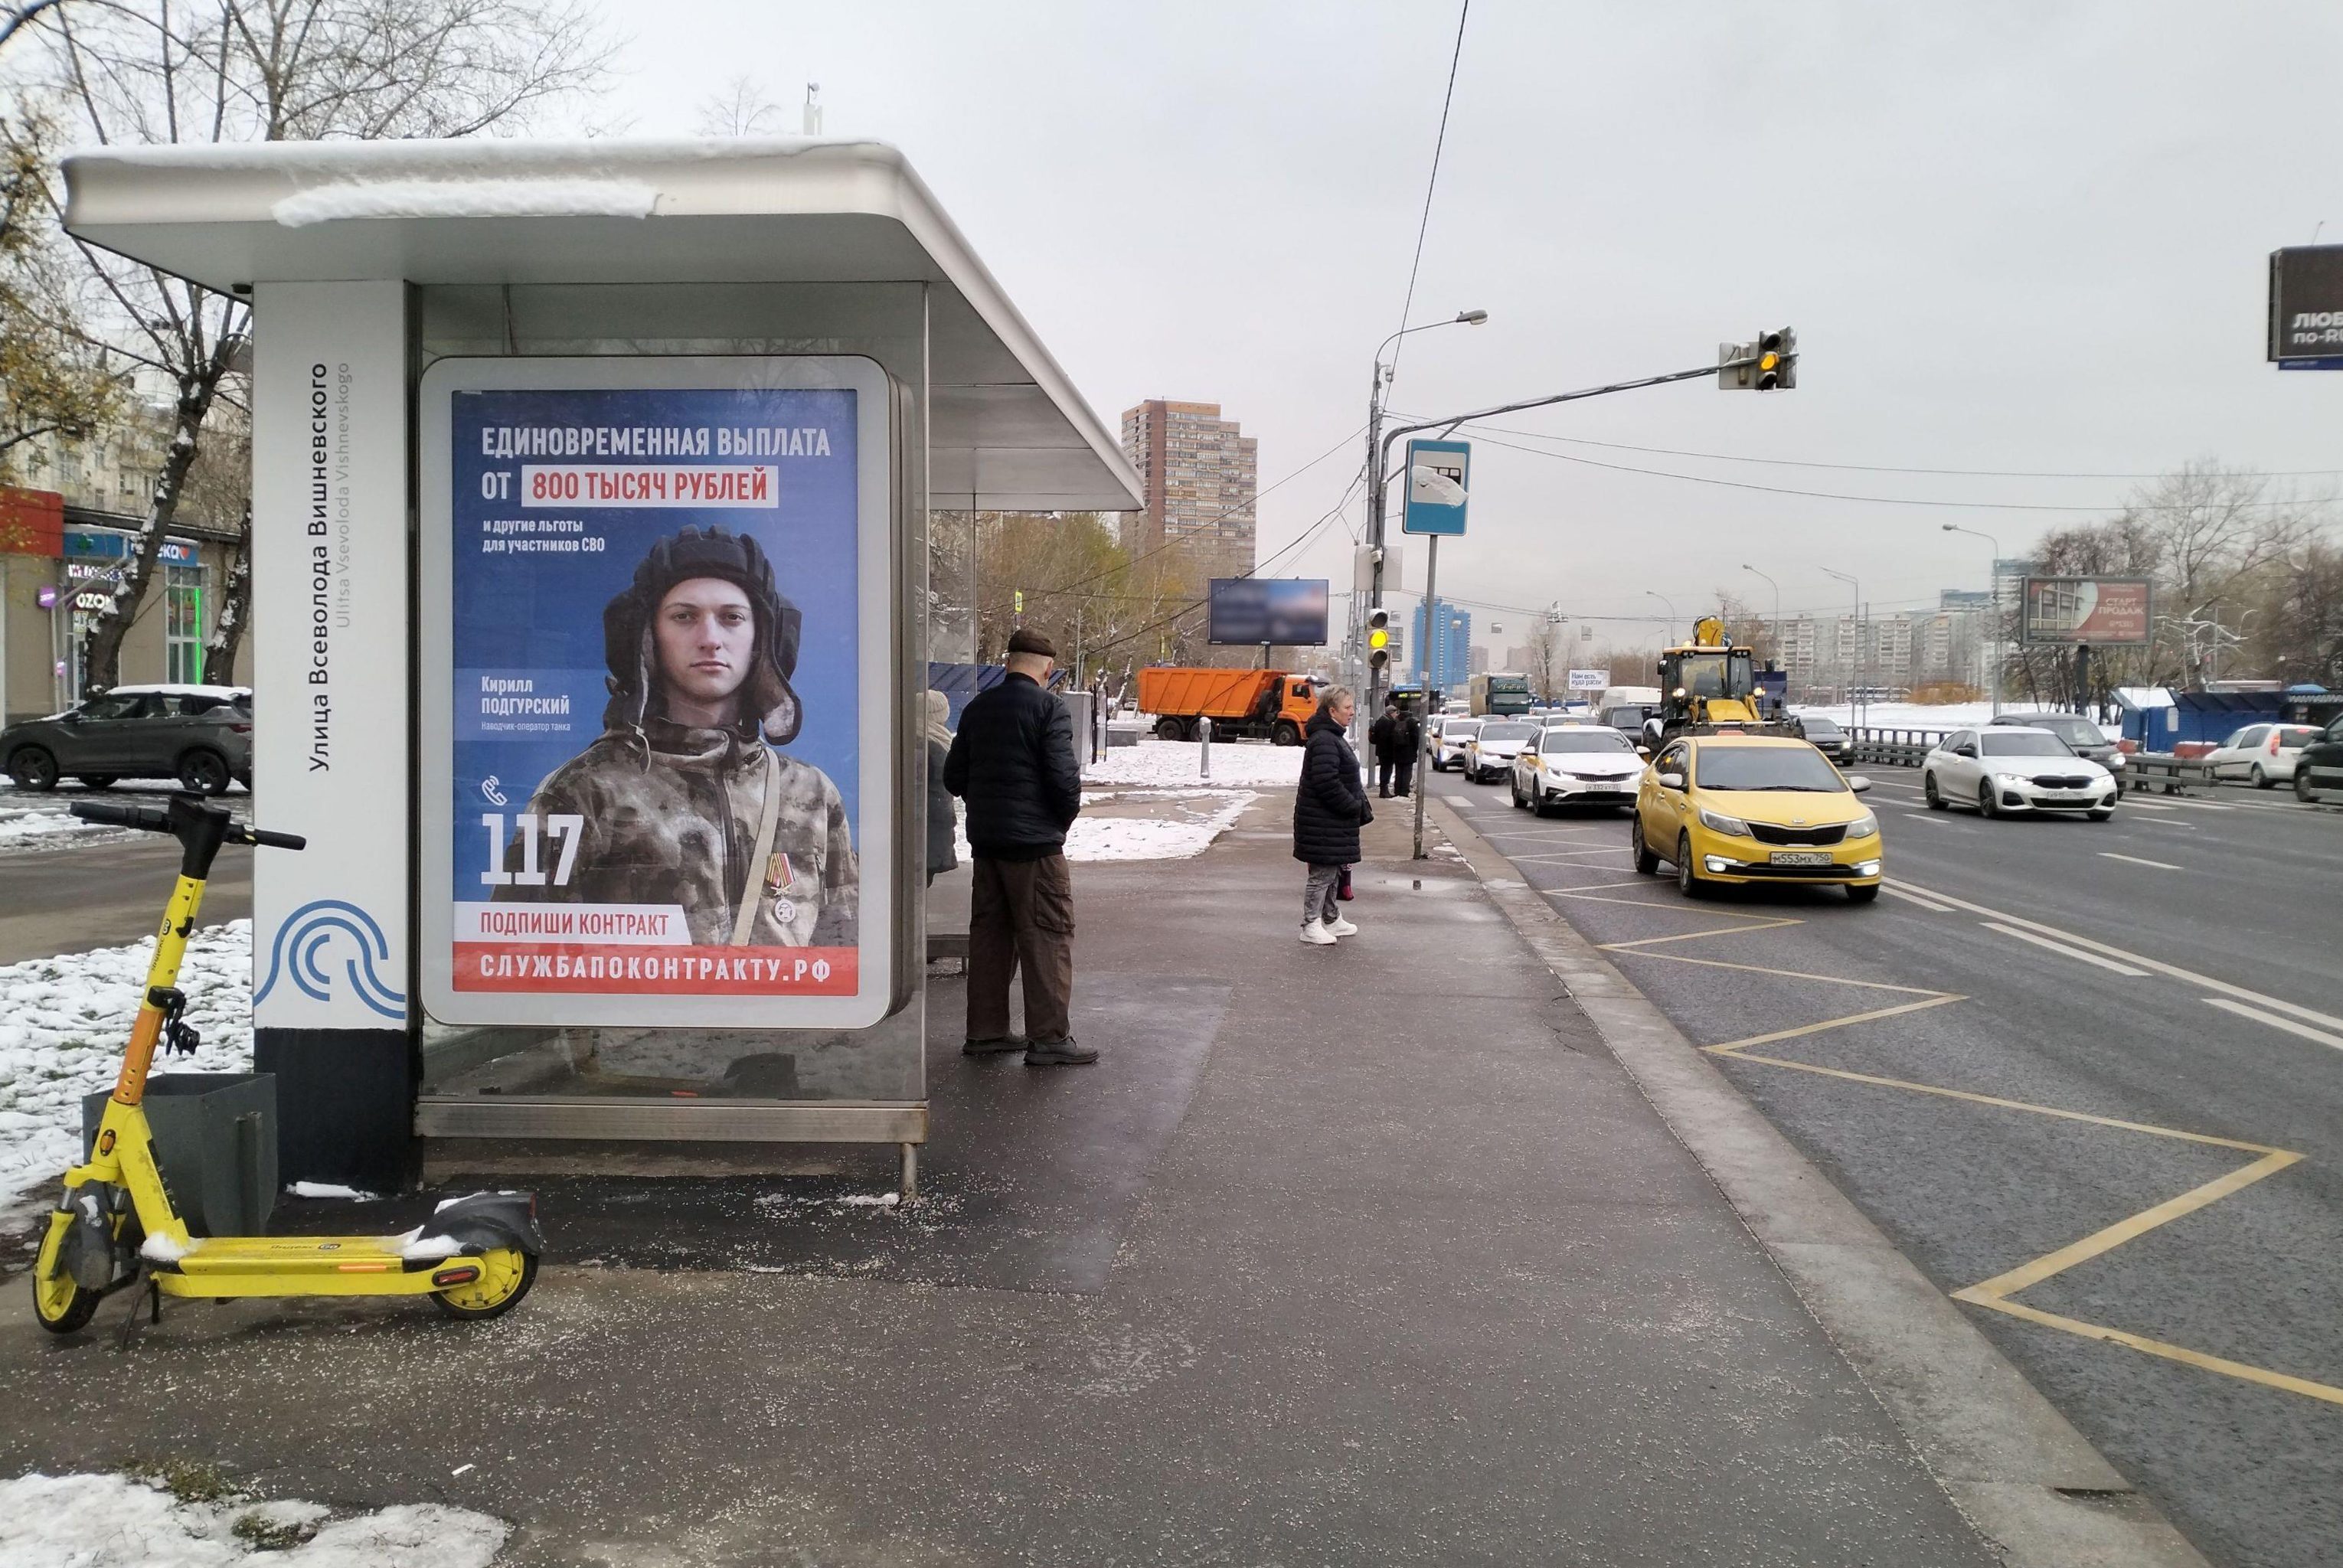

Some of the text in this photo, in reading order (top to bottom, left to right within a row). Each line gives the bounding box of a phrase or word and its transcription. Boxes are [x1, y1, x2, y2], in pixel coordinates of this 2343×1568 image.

[482, 427, 831, 459] ЕДИНОВРЕМЕННАЯ ВЫПЛАТА
[335, 362, 352, 628] Ulitsa Vsevoloda Vishnevskogo
[482, 466, 767, 500] ОТ 800 ТЫСЯЧ РУБЛЕЙ
[483, 520, 583, 535] и другие льготы
[482, 537, 605, 554] для участников СВО
[308, 363, 332, 772] Улица Всеволода Вишневского
[482, 675, 533, 694] Кирилл
[481, 694, 570, 716] ПОДГУРСКИЙ
[481, 721, 570, 733] Наводчик-оператор танка
[480, 813, 584, 886] 117
[480, 911, 669, 936] ПОДПИШИ КОНТРАКТ
[480, 954, 831, 983] СЛУЖБАПОКОНТРАКТУ.РФ
